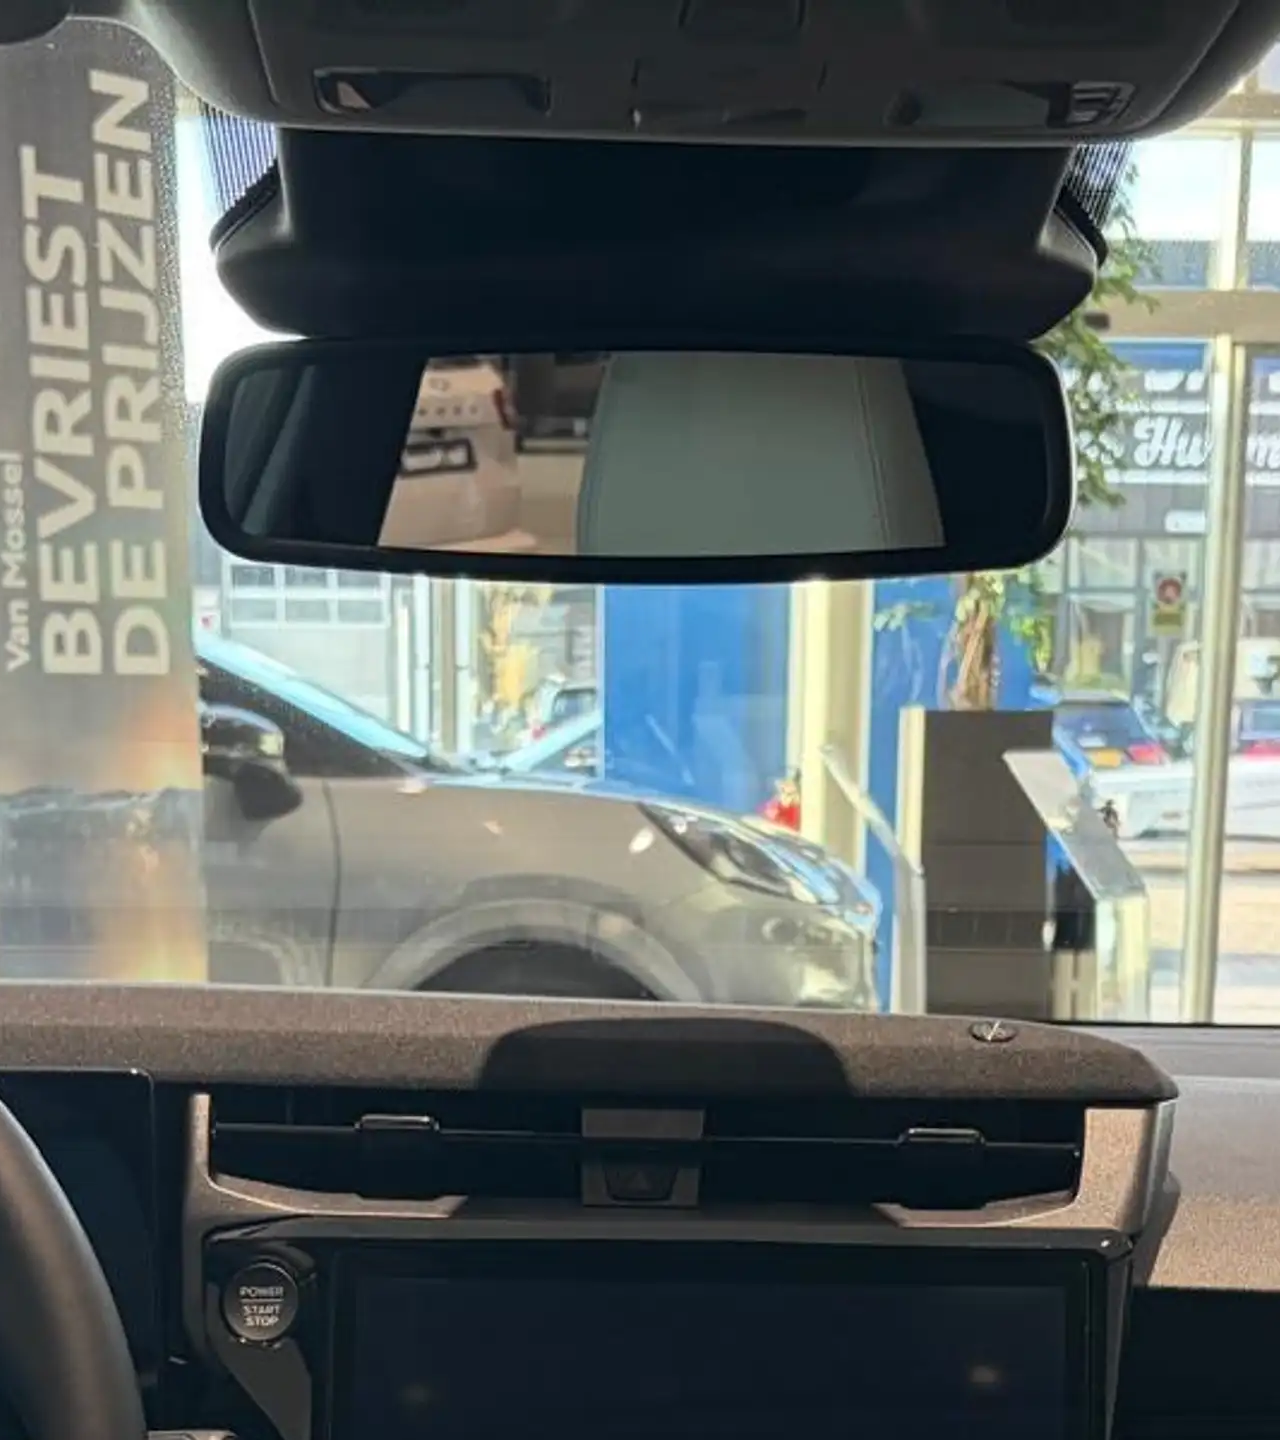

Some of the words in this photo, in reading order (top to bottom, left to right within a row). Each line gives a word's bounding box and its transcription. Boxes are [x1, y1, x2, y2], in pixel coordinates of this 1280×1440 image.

[89, 69, 164, 509] PRIJZEN
[20, 143, 102, 675] BEVRIEST
[4, 598, 31, 672] Van
[109, 539, 170, 675] DE
[239, 1286, 284, 1298] POWER
[242, 1305, 281, 1315] START
[245, 1316, 280, 1326] STOP
